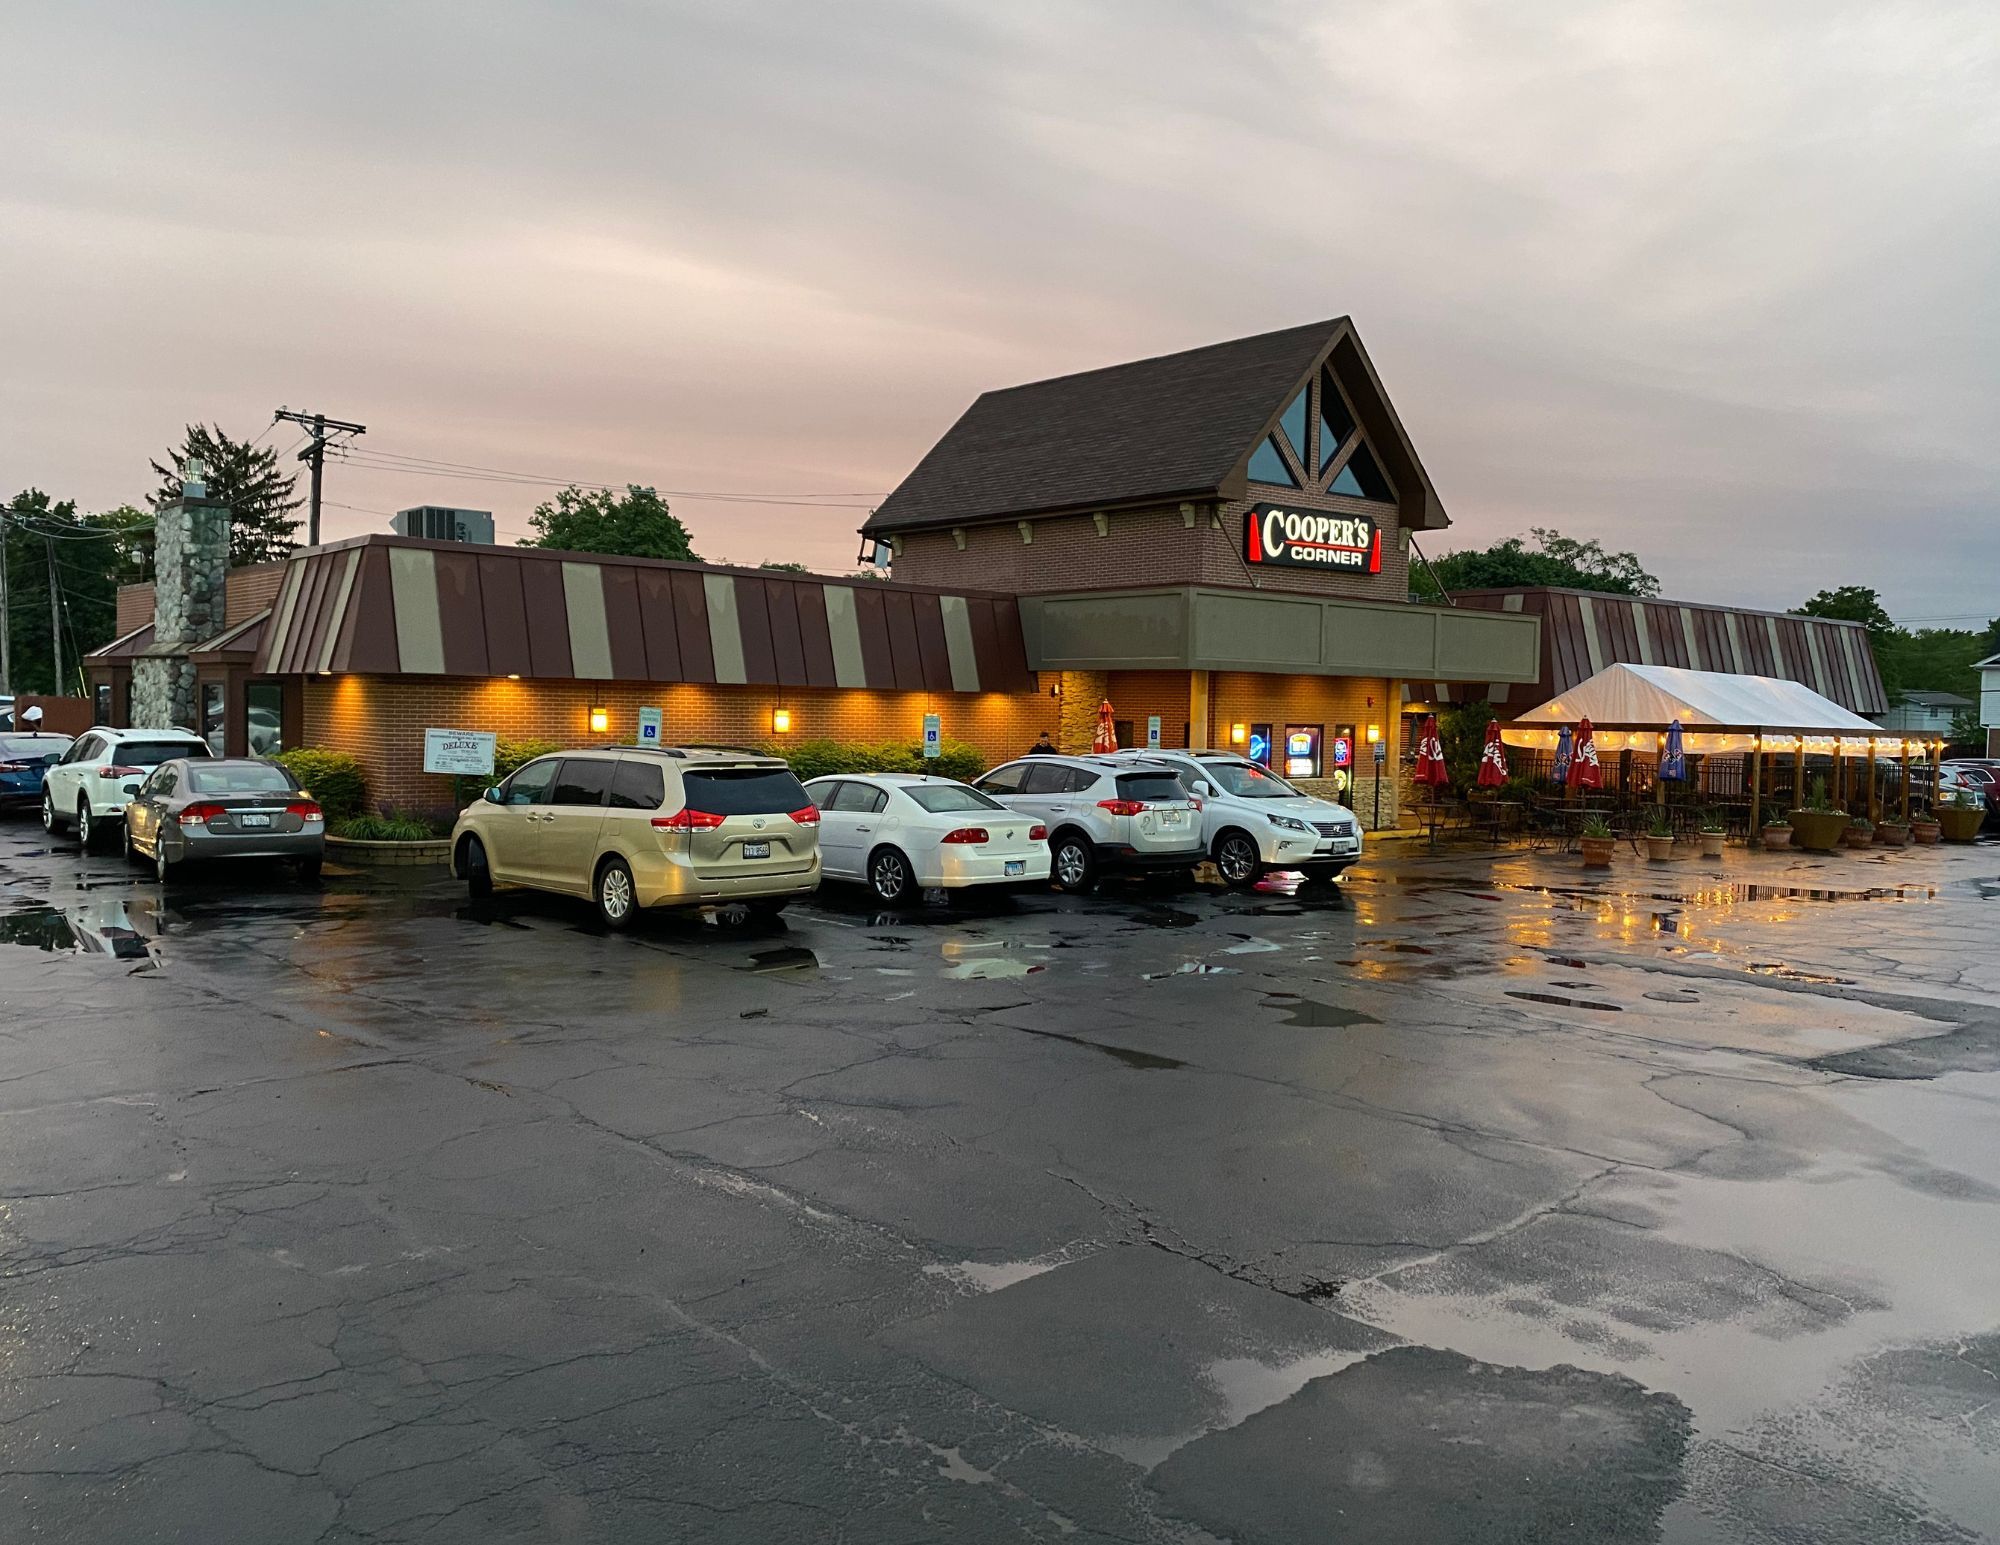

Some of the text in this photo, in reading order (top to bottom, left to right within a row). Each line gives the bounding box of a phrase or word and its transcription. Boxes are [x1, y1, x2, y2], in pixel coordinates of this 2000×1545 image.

[1263, 510, 1369, 557] COOPER'S
[1291, 546, 1362, 566] CORNER
[443, 741, 479, 751] DELUXE
